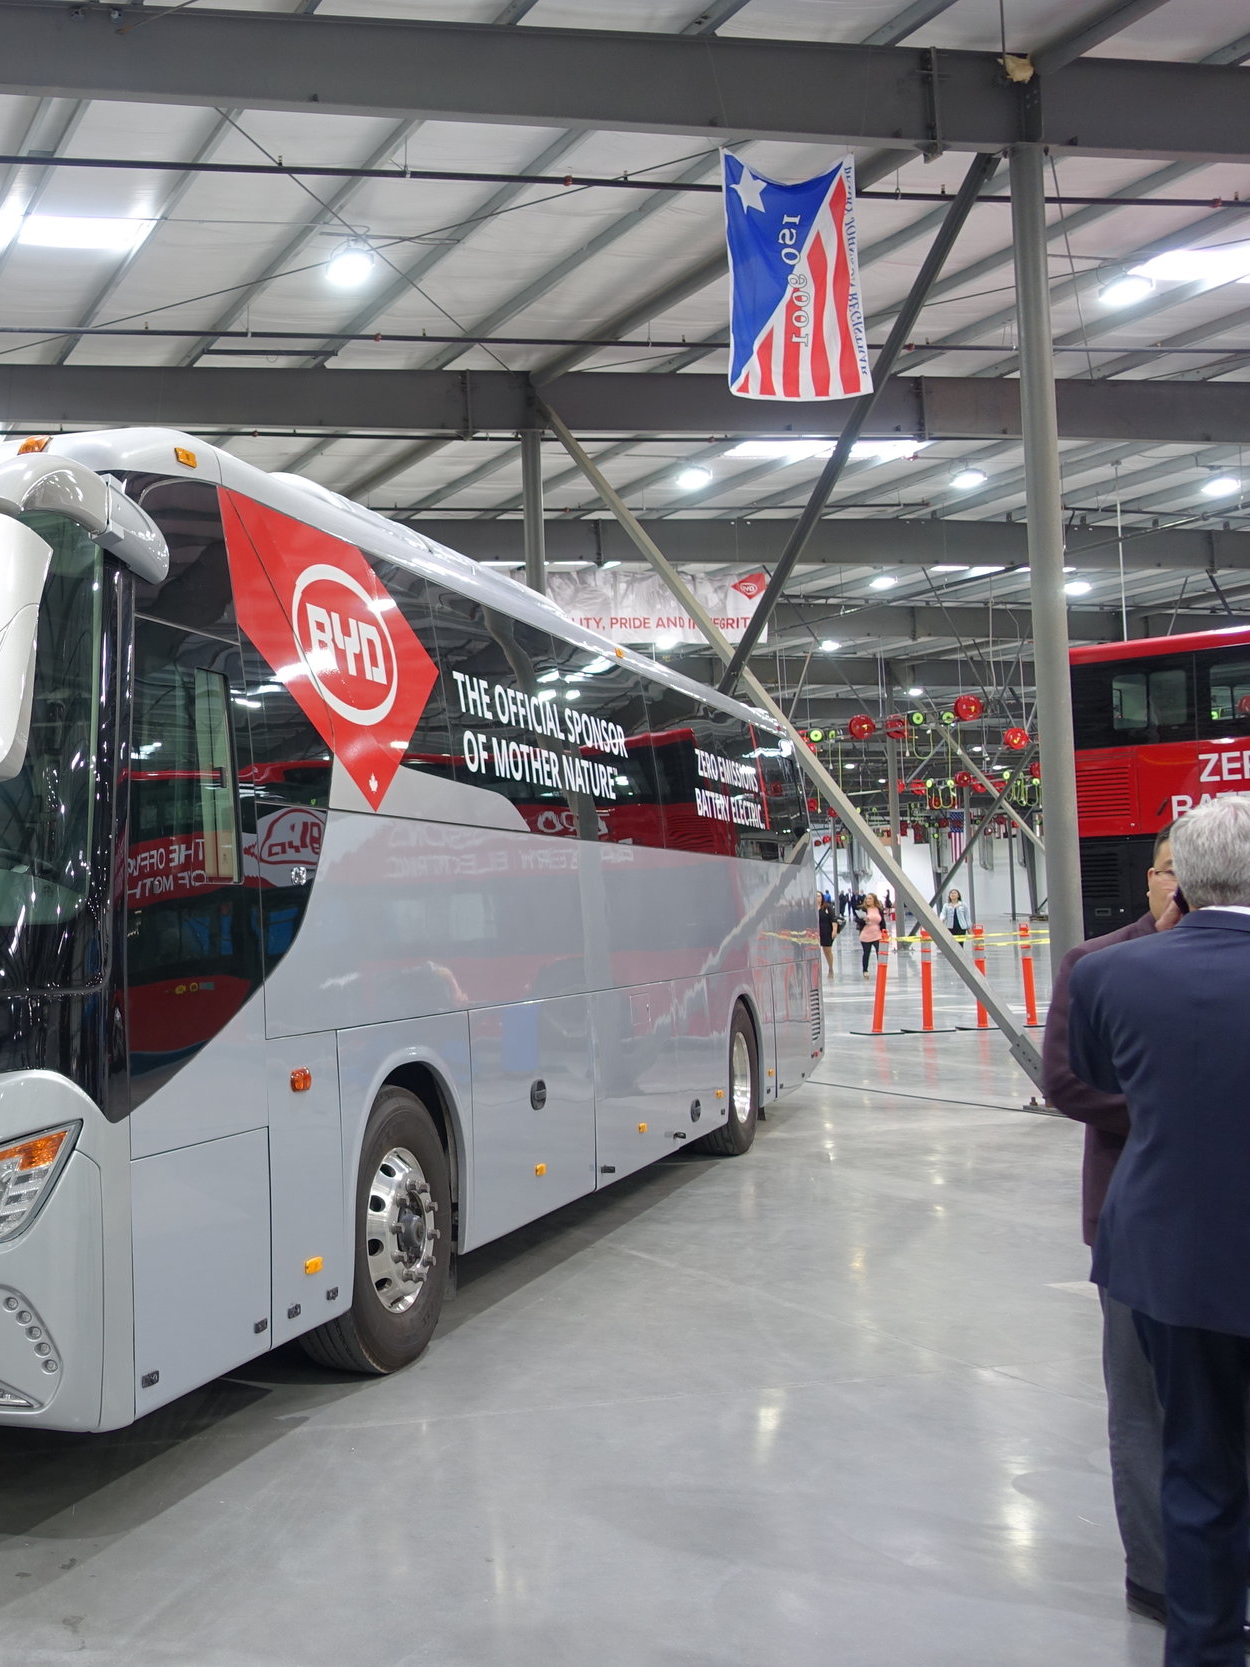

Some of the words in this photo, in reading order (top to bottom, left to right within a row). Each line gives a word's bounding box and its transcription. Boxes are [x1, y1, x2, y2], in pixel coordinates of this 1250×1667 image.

[305, 602, 388, 685] BYD
[610, 616, 651, 630] PRIDE
[656, 616, 685, 629] AND
[688, 617, 753, 630] IEGRIT
[452, 670, 493, 720] THE
[494, 684, 566, 741] OFFICIAL
[564, 707, 628, 759] SPONSOR
[463, 730, 488, 774] OF
[491, 736, 562, 790] MOTHER
[694, 748, 719, 782] ZERO
[717, 756, 759, 793] EMISSIONS
[1198, 749, 1250, 783] ZE
[694, 787, 731, 822] BATTERY
